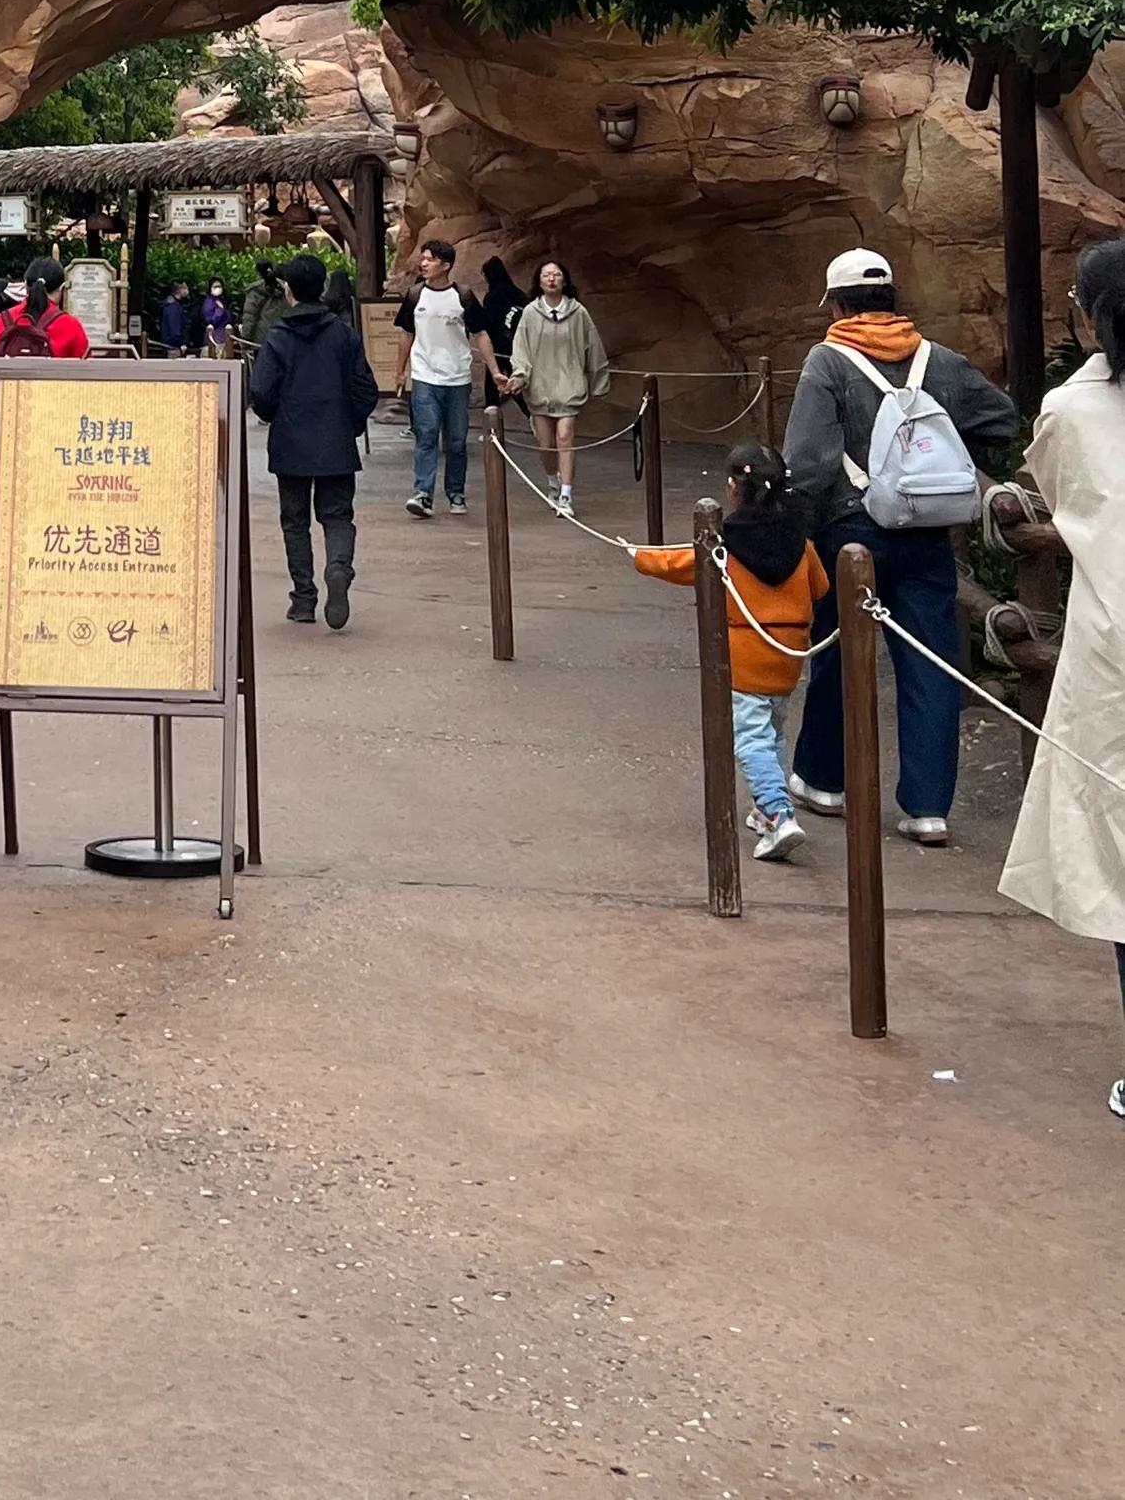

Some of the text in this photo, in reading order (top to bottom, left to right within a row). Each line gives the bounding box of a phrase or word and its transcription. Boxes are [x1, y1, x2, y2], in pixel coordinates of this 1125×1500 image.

[76, 414, 133, 444] 翱翔
[54, 445, 151, 466] 飞越地平线
[75, 474, 134, 492] SOARING
[43, 524, 162, 556] 优先通道
[28, 556, 177, 574] Priority Access Entrance
